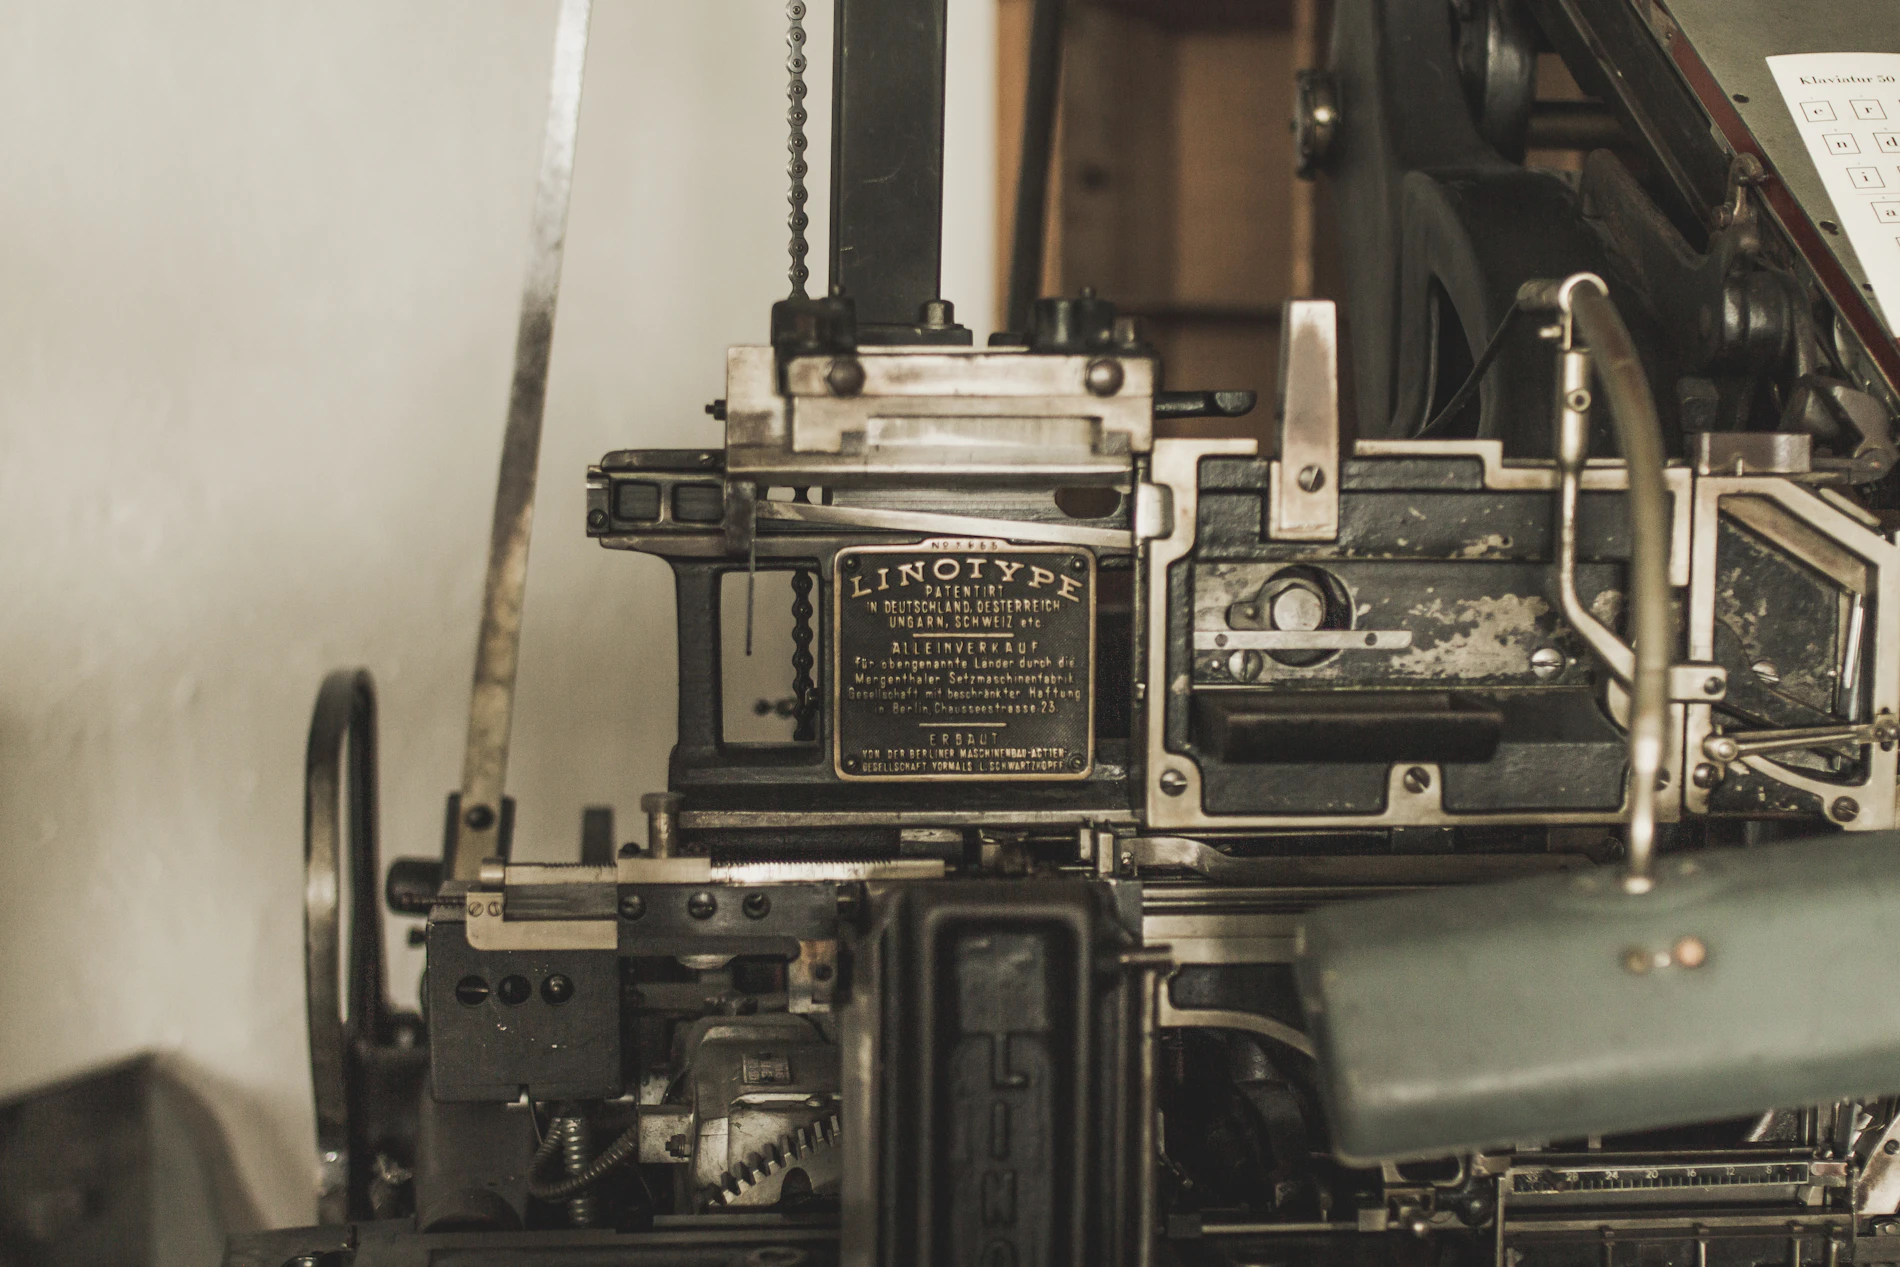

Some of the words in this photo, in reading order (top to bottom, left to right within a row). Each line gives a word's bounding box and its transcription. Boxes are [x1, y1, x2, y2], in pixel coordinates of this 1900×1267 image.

[1886, 136, 1899, 147] d
[850, 558, 1084, 603] LINOTYPE
[925, 584, 1005, 598] PATENTIRT
[866, 601, 878, 613] IN
[884, 600, 973, 614] DEUTSCHLAND,
[889, 615, 949, 629] UNGARN,
[955, 615, 1013, 628] SCHWEIZ
[892, 641, 1039, 655] ALLEINVERKAUF
[881, 656, 968, 673] obengenannte
[974, 656, 1014, 669] Länder
[1019, 656, 1052, 668] durch
[1058, 656, 1076, 668] die
[855, 672, 941, 689] Mergenthaler
[949, 671, 1074, 685] Setzmaschinenfabrik
[848, 686, 919, 700] Gesellschaft
[925, 687, 942, 699] mit
[947, 687, 1021, 699] beschränkter
[1029, 686, 1081, 702] Haftung
[929, 732, 998, 746] ERBAUT
[862, 748, 880, 759] VON
[887, 748, 905, 759] DER
[909, 748, 955, 759] BERLINER
[862, 761, 927, 772] GESELLSCHAFT
[932, 761, 973, 772] VORMALS
[989, 760, 1064, 772] SCHWARTZKOPFF
[1605, 1170, 1619, 1181] 24
[1645, 1169, 1659, 1180] 20
[1687, 1167, 1697, 1178] 16
[1727, 1167, 1735, 1176] 12
[1766, 1165, 1773, 1175] 8
